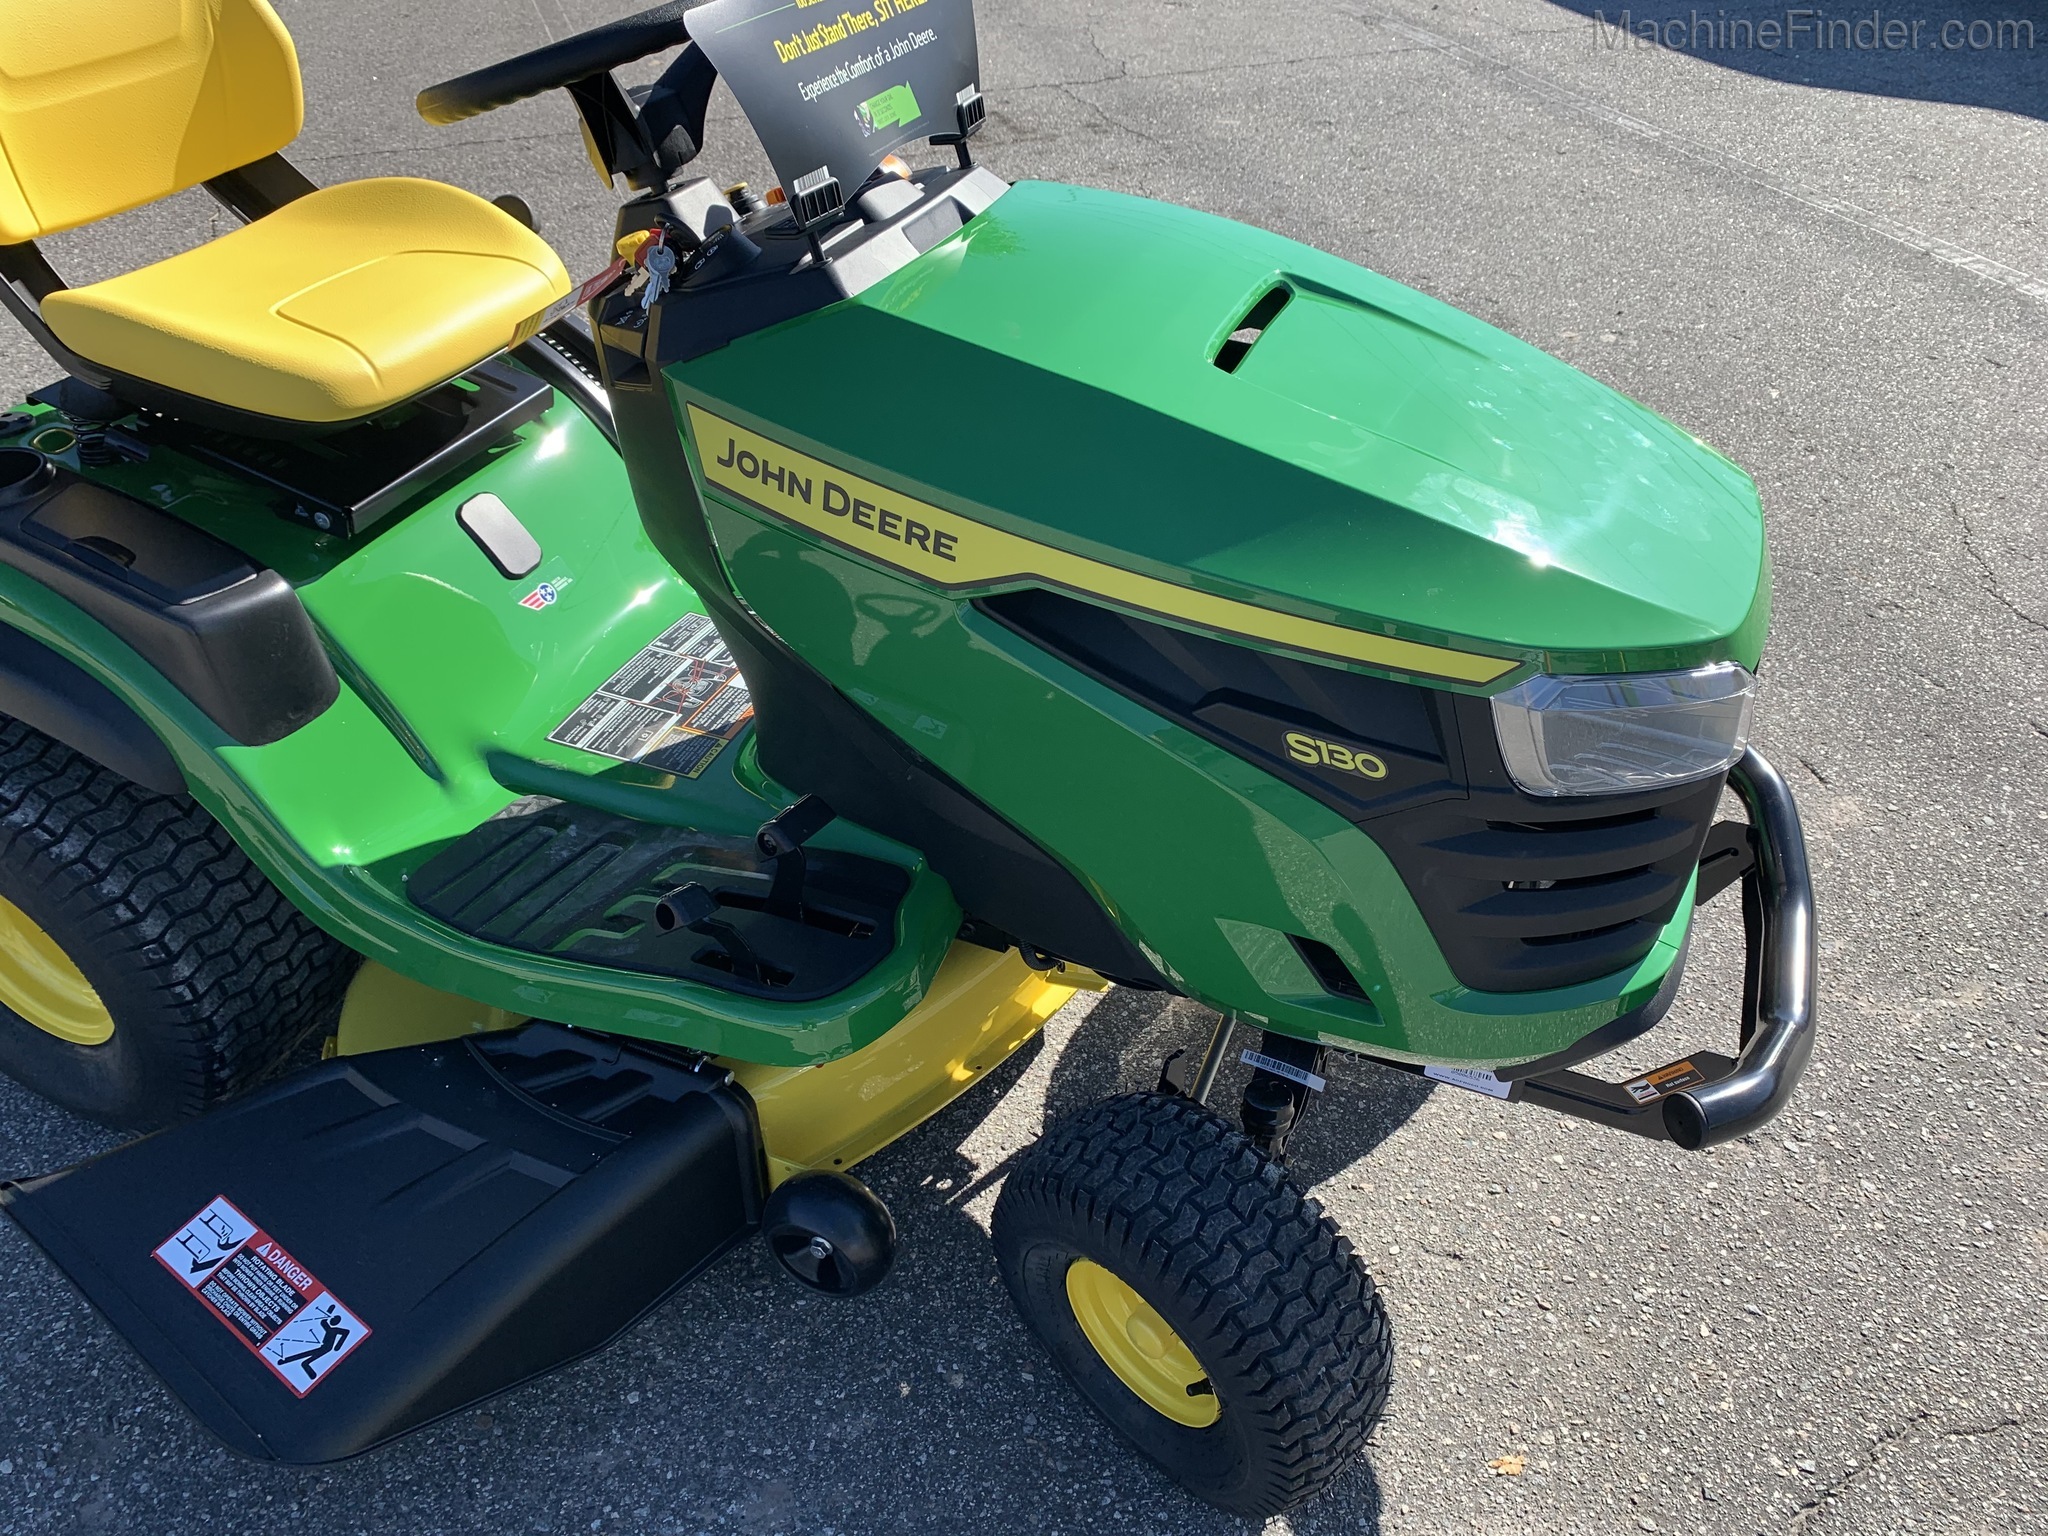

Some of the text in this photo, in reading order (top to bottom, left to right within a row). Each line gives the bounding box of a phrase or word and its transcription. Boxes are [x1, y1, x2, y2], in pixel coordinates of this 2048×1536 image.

[773, 33, 805, 64] Don't
[801, 24, 823, 55] Just
[817, 15, 848, 46] Stand
[841, 11, 879, 35] There,
[797, 28, 938, 102] Experience the Comfort of a John Deere.
[717, 438, 958, 562] JOHN DEERE
[1285, 732, 1387, 779] S130
[234, 1269, 280, 1313] THROWN OBJECTS
[250, 1256, 296, 1297] ROTATING BLADE
[266, 1249, 314, 1291] DANGER
